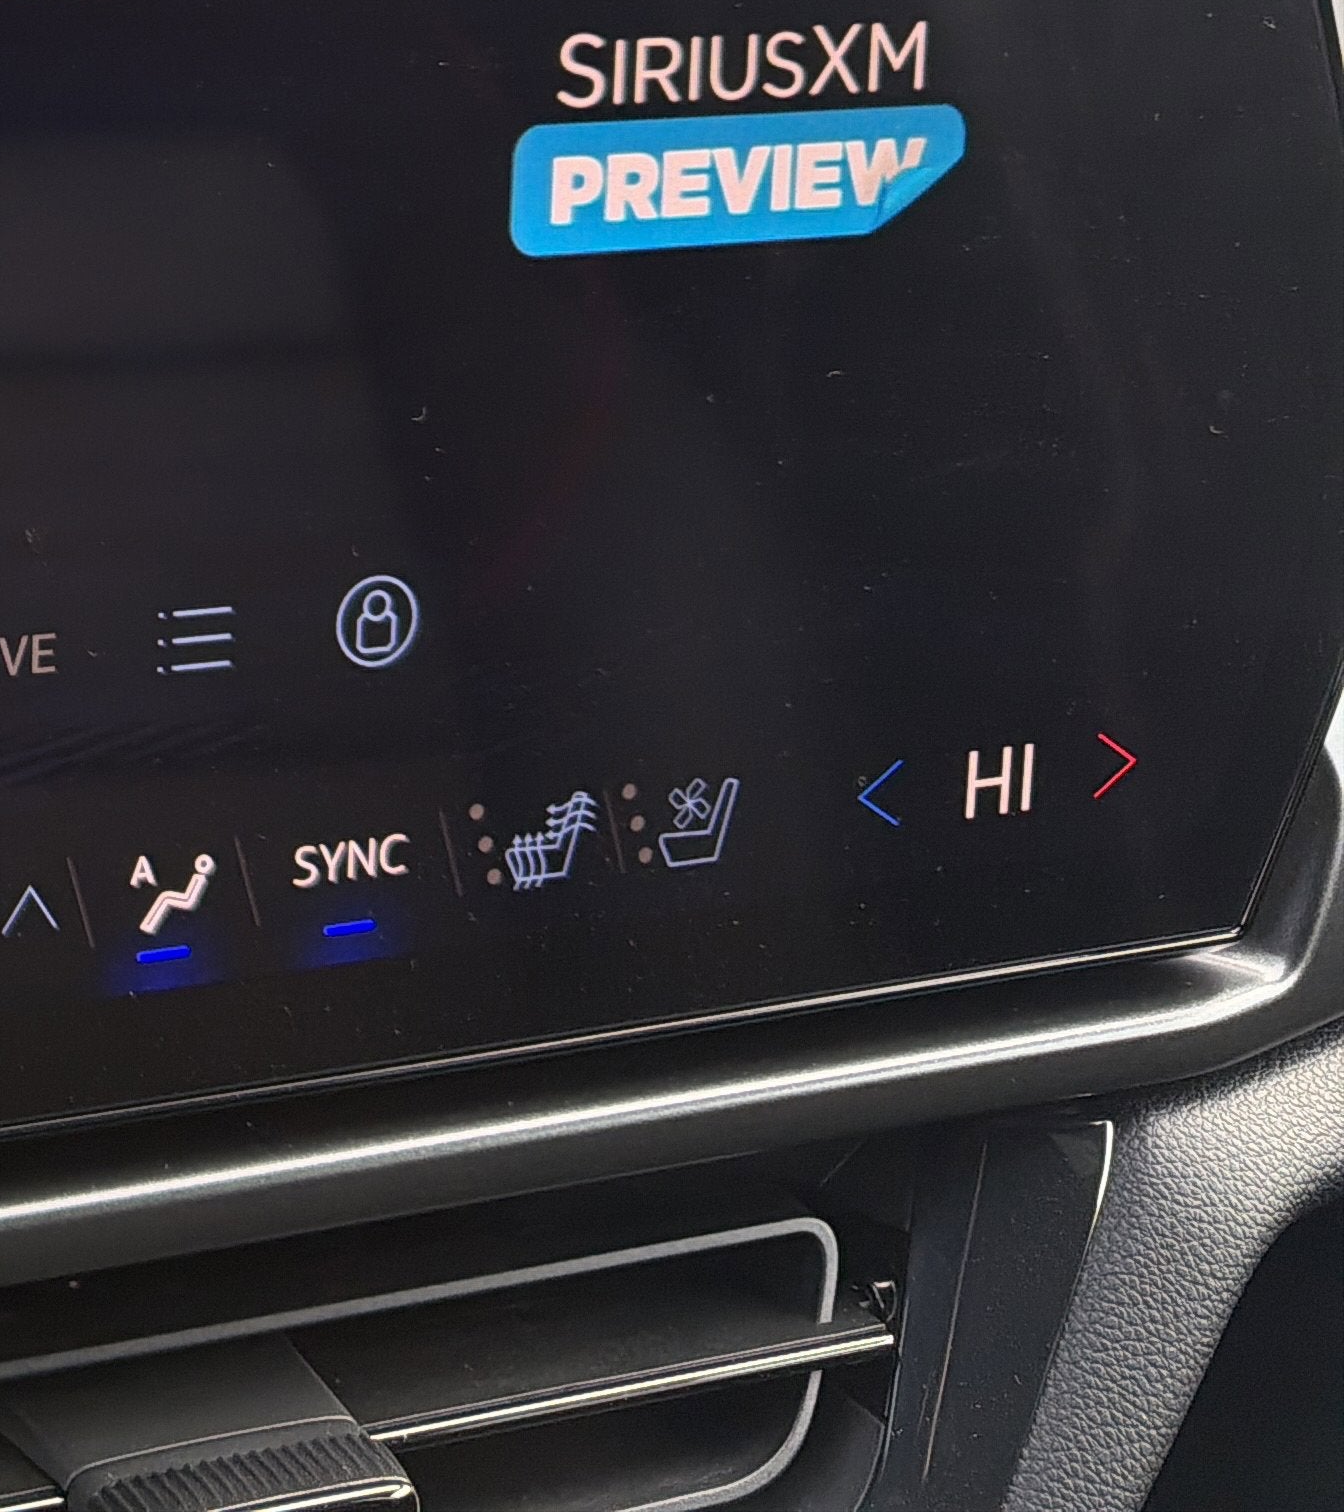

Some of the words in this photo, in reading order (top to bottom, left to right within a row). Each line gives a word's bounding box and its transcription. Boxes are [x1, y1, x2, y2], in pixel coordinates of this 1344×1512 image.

[557, 20, 929, 109] SIRIUSXM
[550, 138, 928, 226] PREVIEW
[965, 743, 1035, 820] HI
[129, 855, 156, 887] A
[292, 833, 408, 888] SYNC
